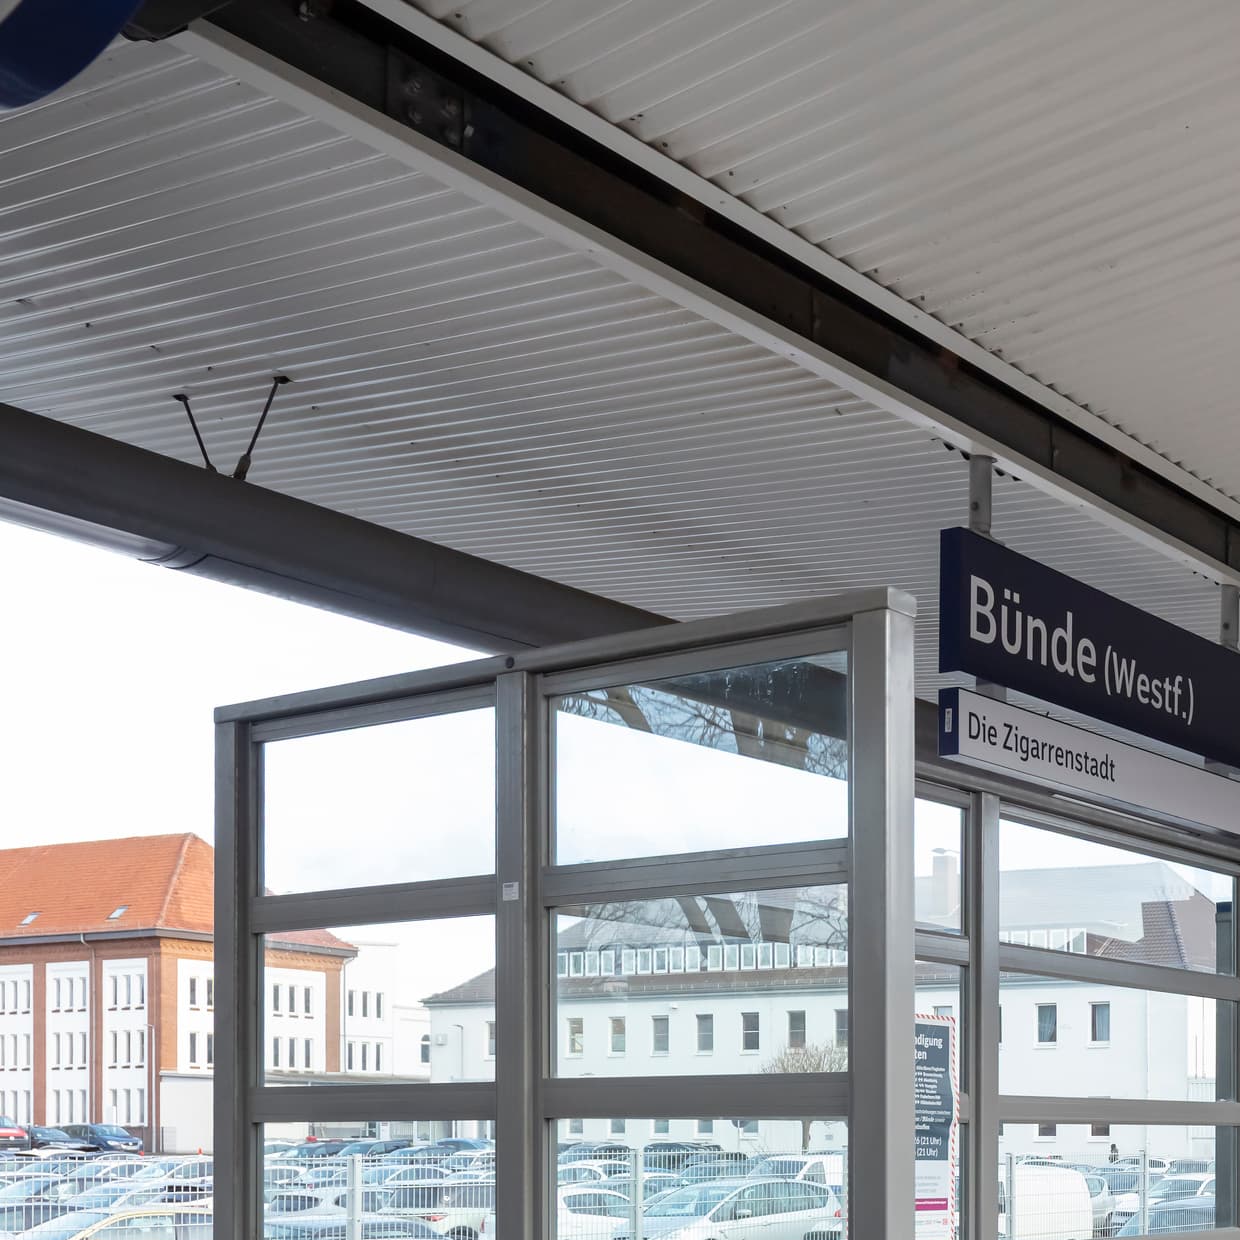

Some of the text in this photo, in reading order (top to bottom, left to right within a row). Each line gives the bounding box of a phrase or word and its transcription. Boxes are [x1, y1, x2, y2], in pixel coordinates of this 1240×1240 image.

[969, 574, 1194, 726] Bünde (Westf.)
[968, 711, 1115, 782] Die Zigarrenstadt
[915, 1033, 943, 1049] digung
[915, 1049, 927, 1060] ten
